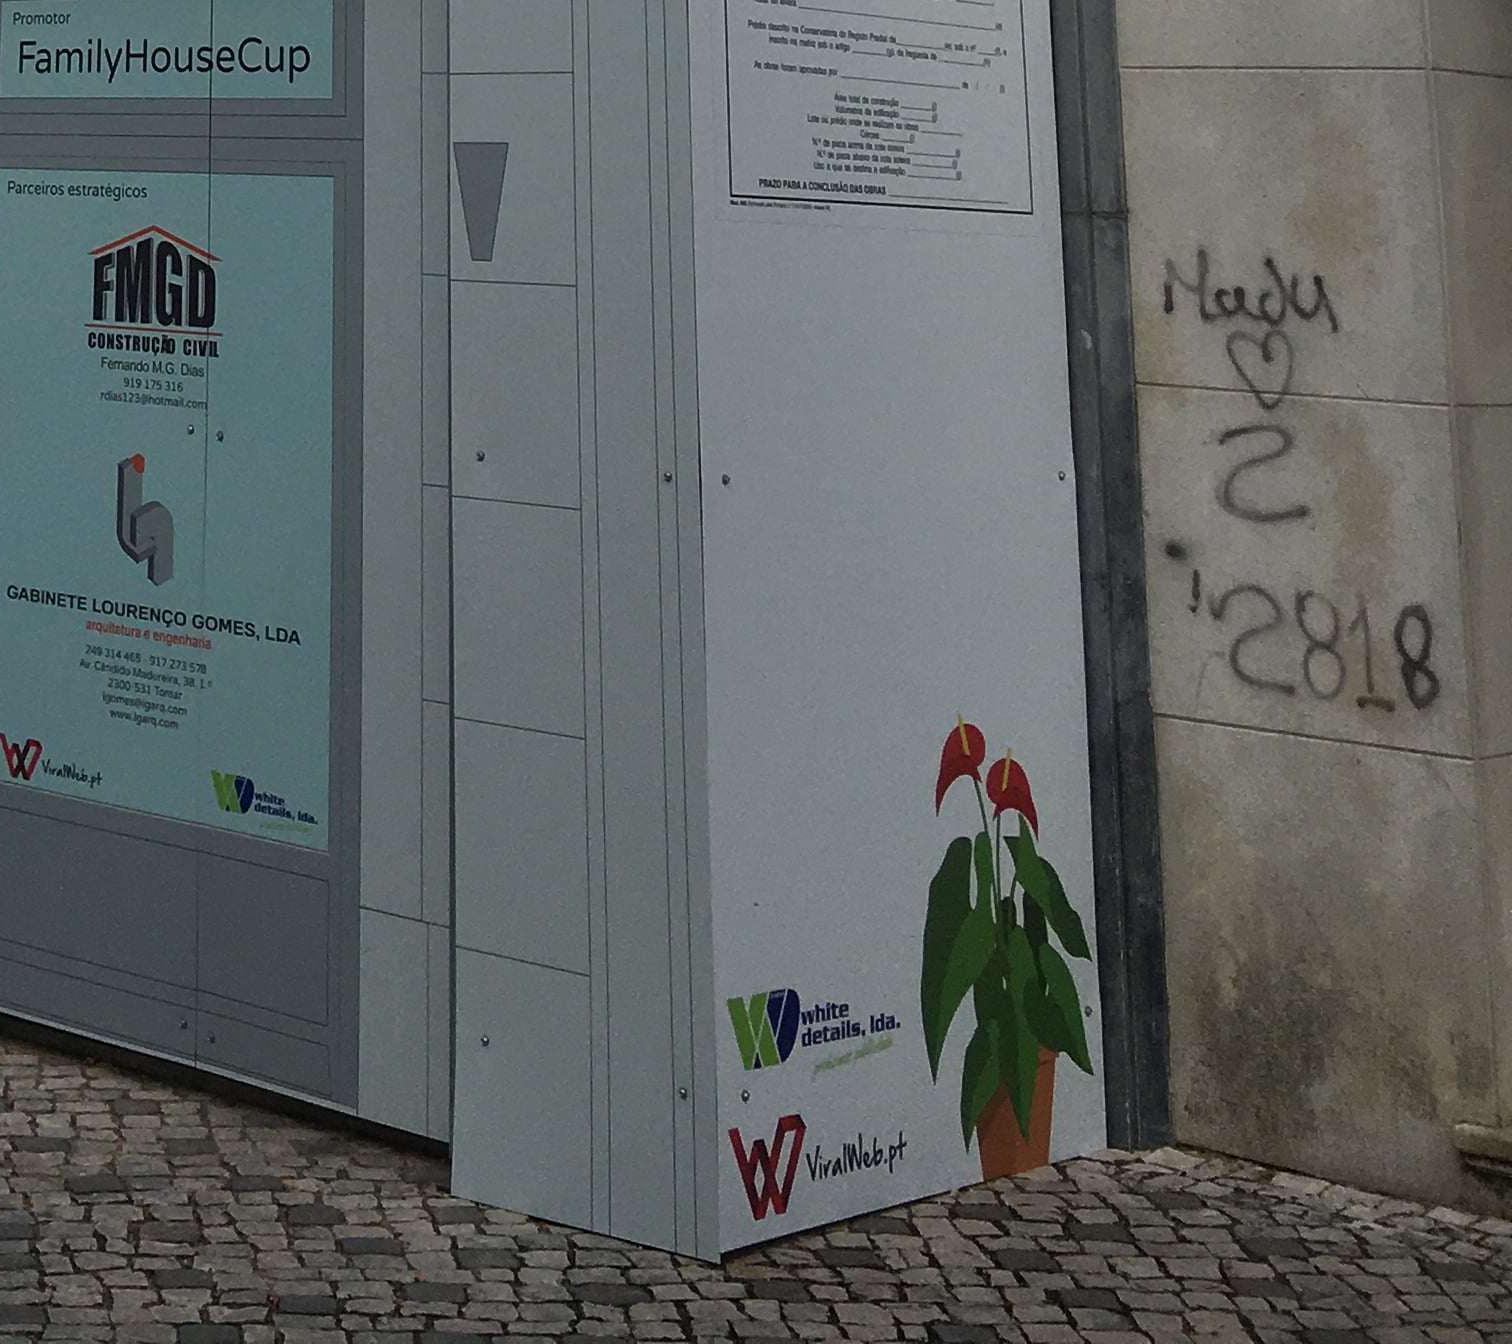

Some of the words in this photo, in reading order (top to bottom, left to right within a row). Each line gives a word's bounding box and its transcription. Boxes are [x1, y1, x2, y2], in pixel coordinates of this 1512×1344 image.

[12, 11, 71, 26] Promotor
[17, 37, 311, 83] FamilyHouseCup
[6, 180, 65, 197] Parceiros
[67, 182, 148, 202] estratégicos
[93, 237, 216, 328] FMGD
[88, 331, 176, 357] CONSTRUÇÃO
[183, 339, 220, 358] CIVIL
[101, 357, 150, 374] Fernando
[180, 362, 205, 378] Dias
[123, 377, 141, 389] 919
[145, 378, 162, 391] 175
[164, 380, 183, 393] 316
[100, 390, 207, 410] rdias123@hotmail.com
[7, 584, 88, 611] GABINETE
[92, 598, 187, 628] LOURENÇO
[192, 614, 260, 641] GOMES,
[265, 625, 301, 646] LDA
[152, 630, 212, 650] engenharia
[169, 659, 187, 671] 273
[41, 759, 102, 789] ViralWeb.pt
[254, 792, 286, 806] white
[801, 1002, 850, 1026] white
[801, 1020, 866, 1048] details,
[869, 1012, 901, 1034] lda.
[805, 1130, 907, 1182] ViralWeb.pt
